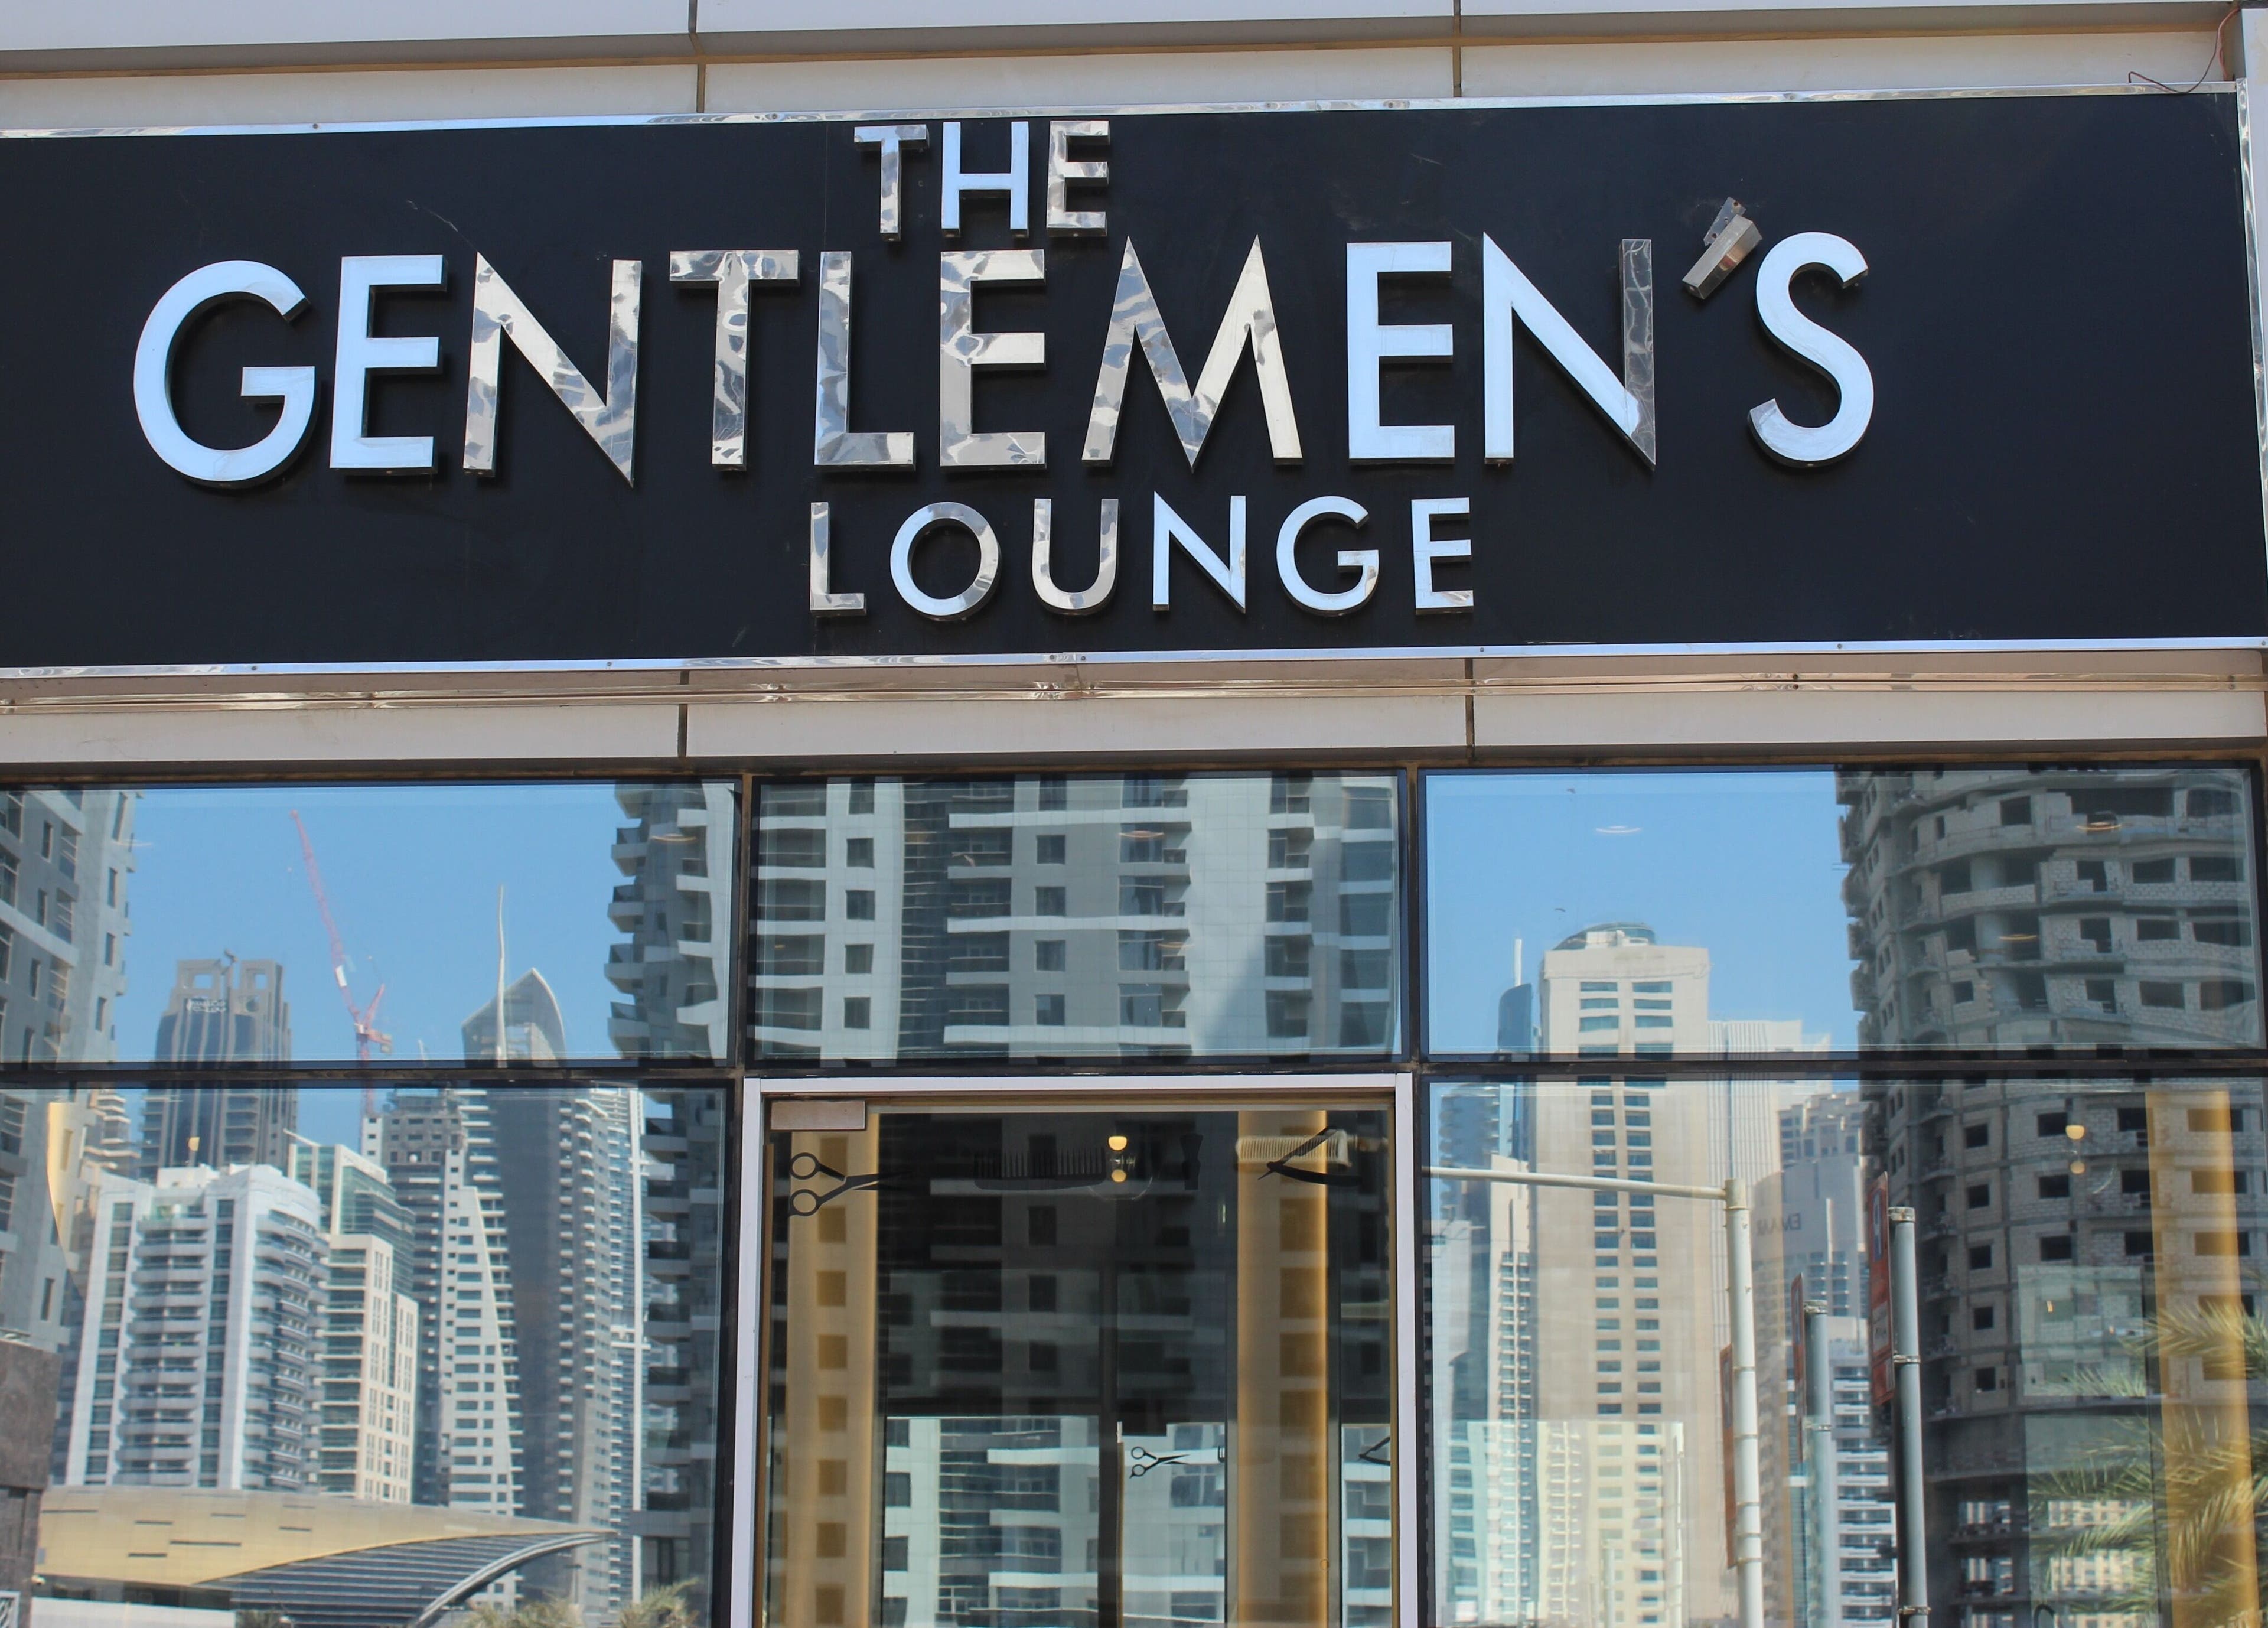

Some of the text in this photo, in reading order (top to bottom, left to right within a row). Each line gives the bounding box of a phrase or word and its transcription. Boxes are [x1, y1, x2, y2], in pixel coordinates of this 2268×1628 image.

[854, 121, 1110, 241] THE
[133, 197, 1875, 489] GENTLEMEN'S
[810, 491, 1475, 618] LOUNGE
